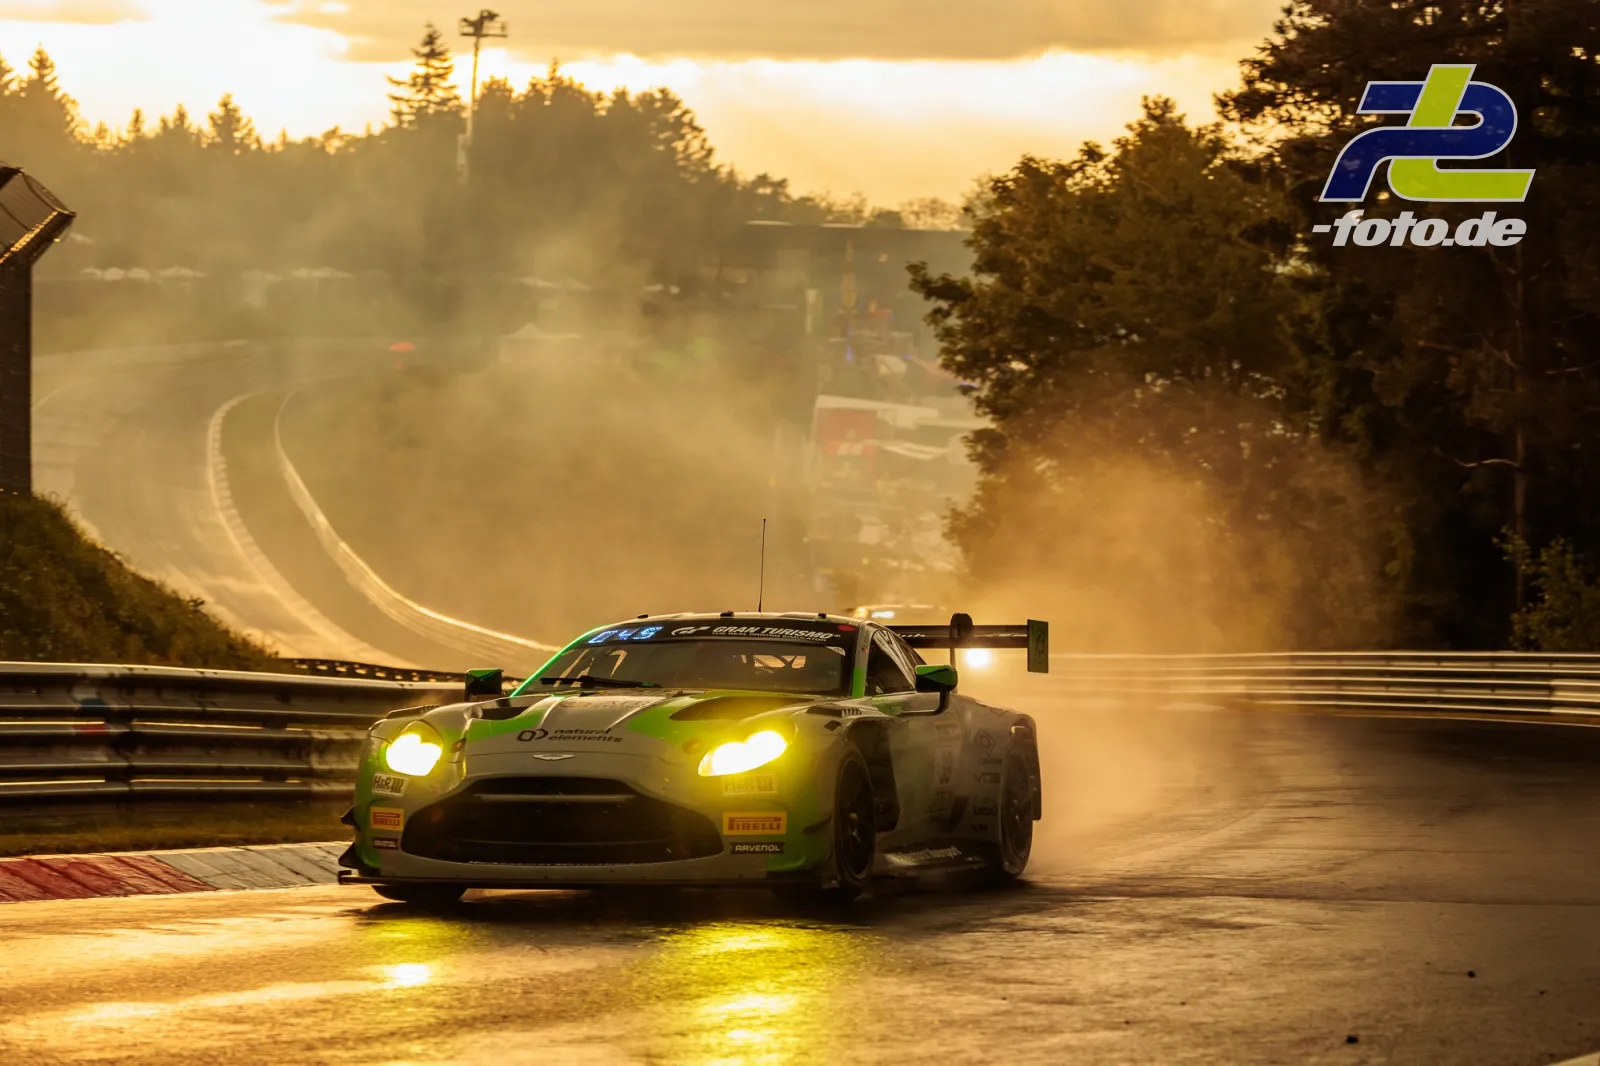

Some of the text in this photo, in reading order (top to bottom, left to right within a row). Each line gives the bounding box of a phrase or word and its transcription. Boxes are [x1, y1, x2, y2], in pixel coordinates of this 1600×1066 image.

[712, 626, 761, 634] GRAN
[760, 627, 834, 639] TURISMO
[548, 734, 624, 743] elements
[727, 816, 783, 832] PIRELLI
[734, 844, 781, 852] RAVENOL
